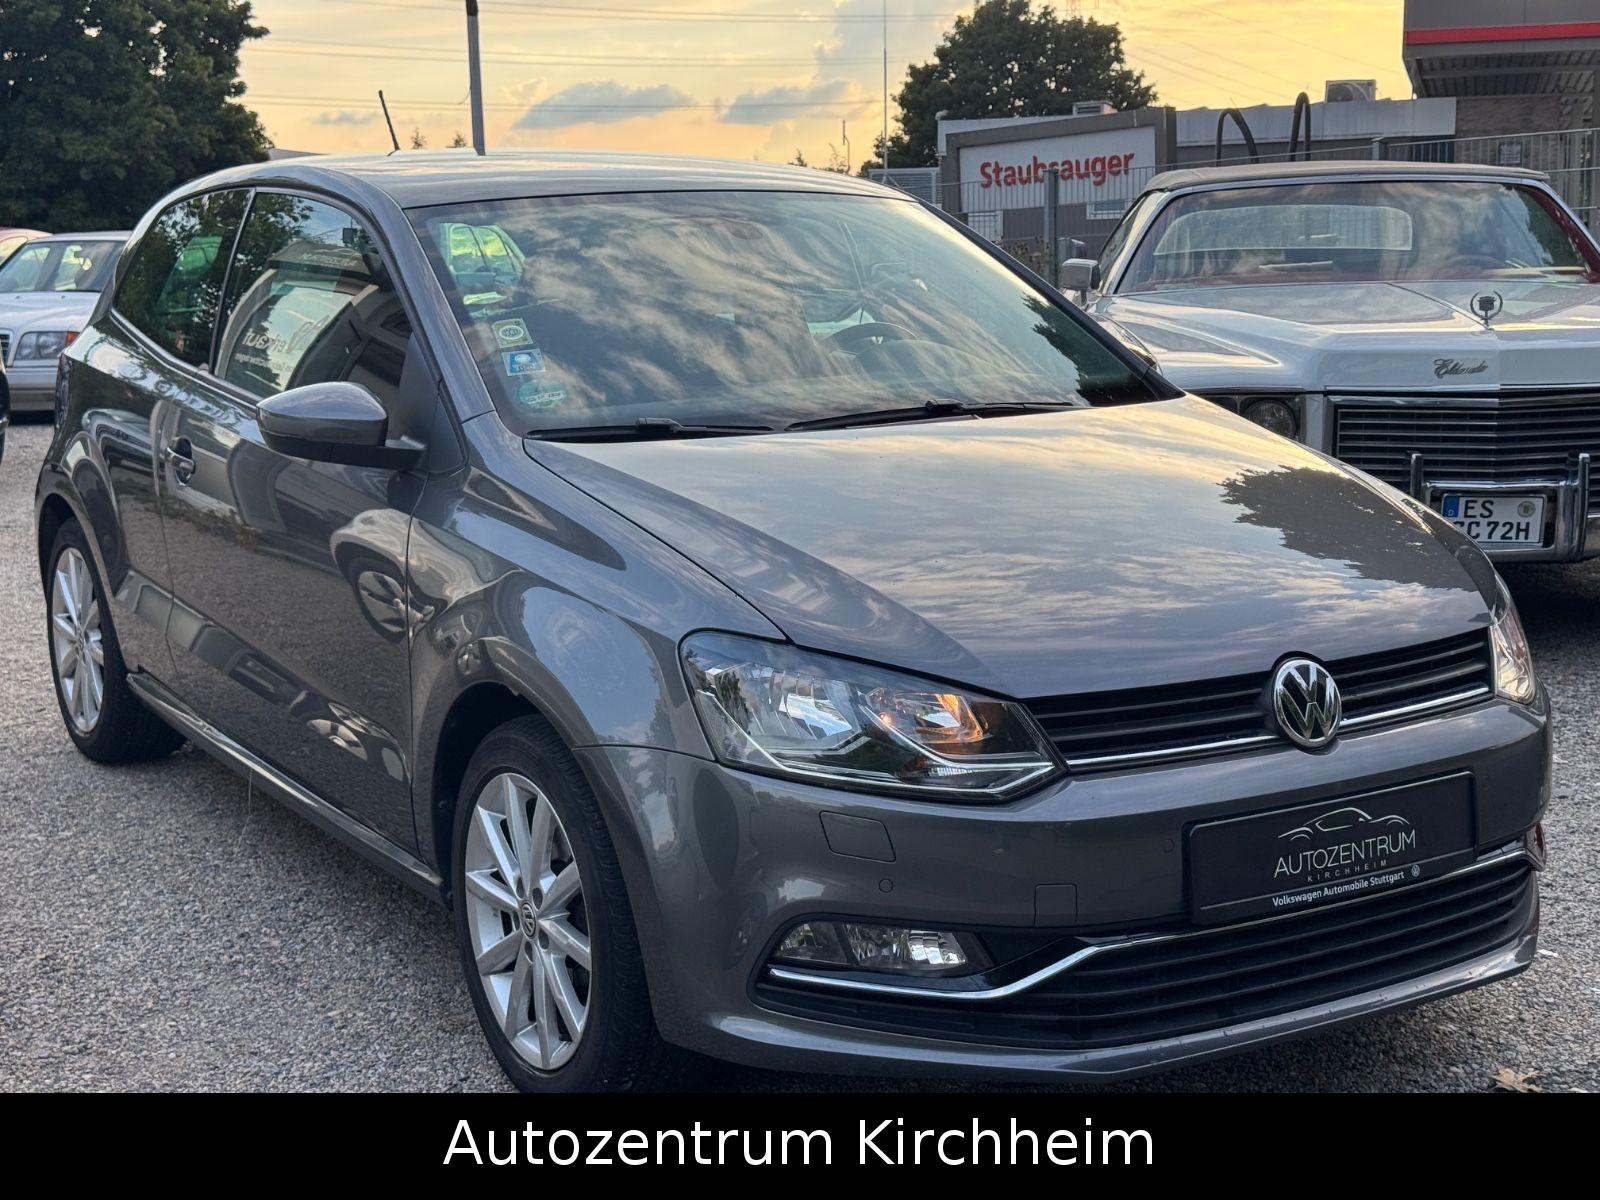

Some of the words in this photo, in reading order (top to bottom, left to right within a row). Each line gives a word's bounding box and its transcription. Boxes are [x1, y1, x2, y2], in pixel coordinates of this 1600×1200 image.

[1463, 500, 1495, 519] ES
[1486, 521, 1530, 540] 72H
[1273, 829, 1416, 878] AUTOZENTRUM
[1307, 860, 1387, 882] KIRCHHEIM
[1272, 889, 1323, 906] Volkswagen
[1323, 879, 1369, 897] Automobile
[1370, 870, 1405, 886] Stuttgart
